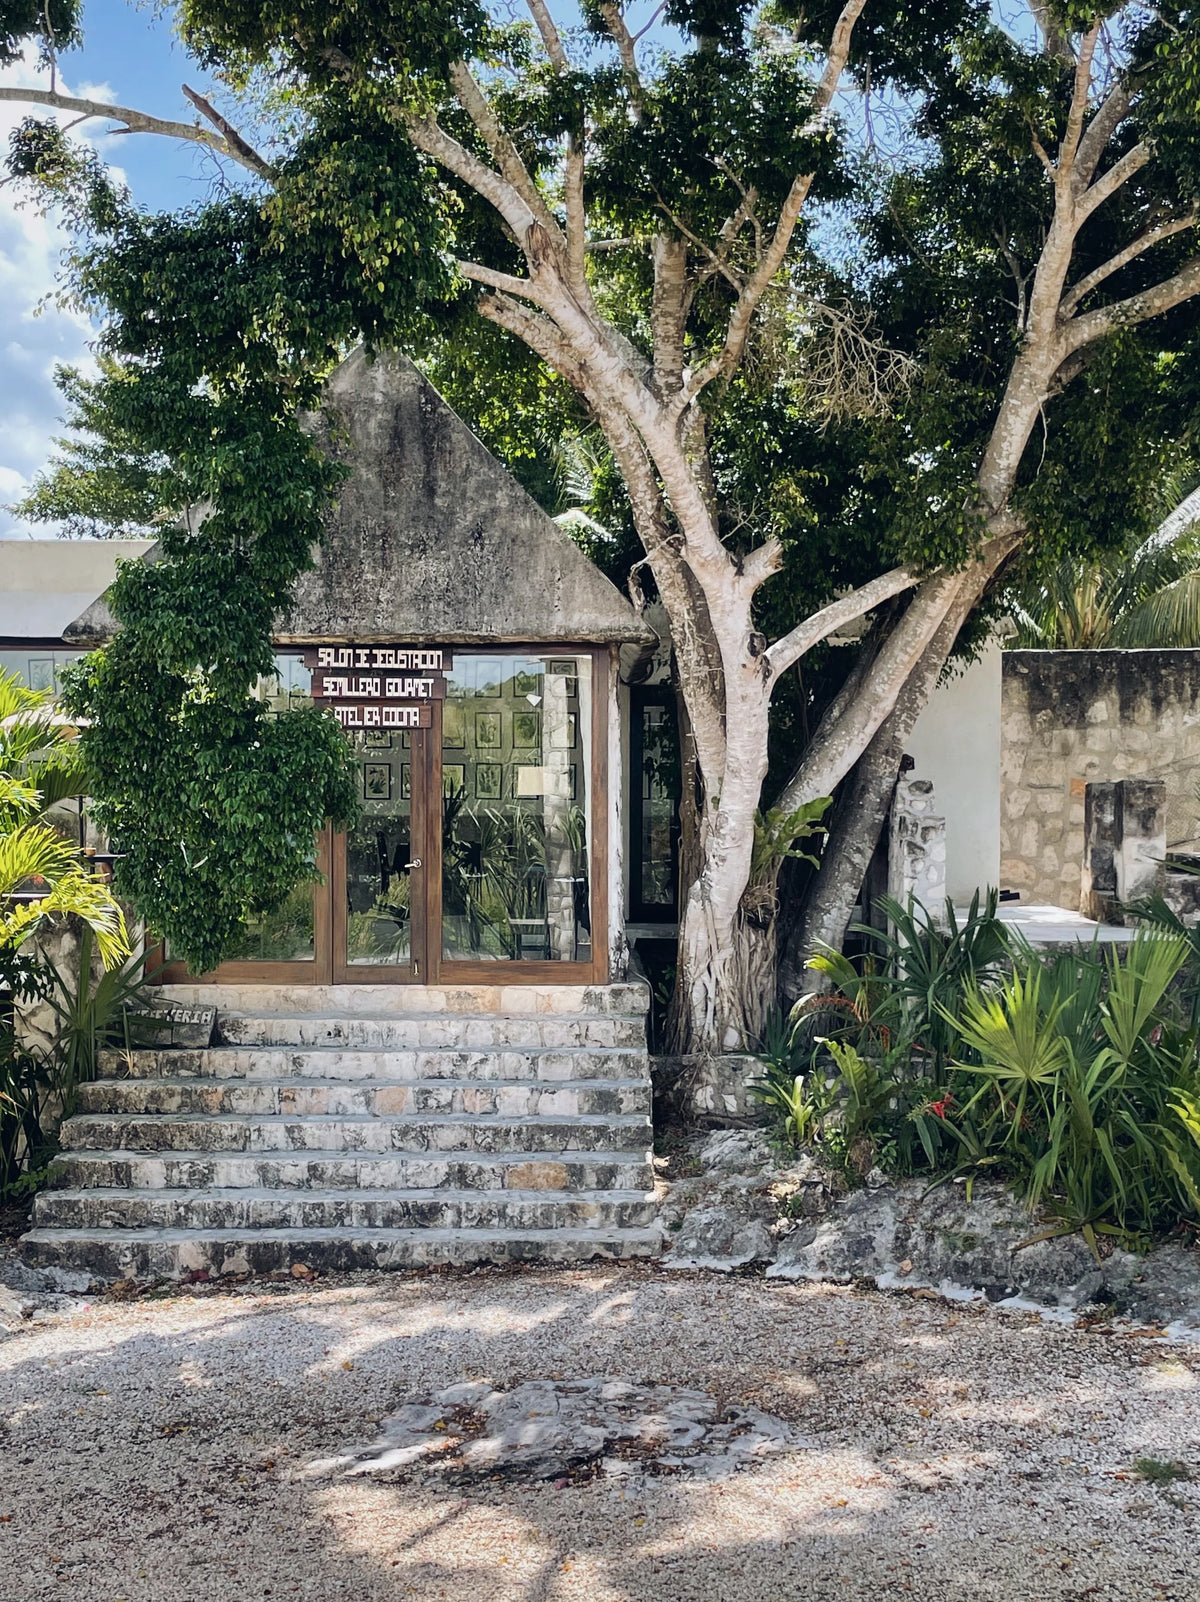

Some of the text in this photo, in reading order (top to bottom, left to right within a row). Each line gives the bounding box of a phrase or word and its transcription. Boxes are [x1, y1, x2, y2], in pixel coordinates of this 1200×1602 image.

[317, 647, 353, 668] SALON
[322, 677, 434, 697] SEMILLERO GOURMET
[334, 706, 380, 726] ATELIER
